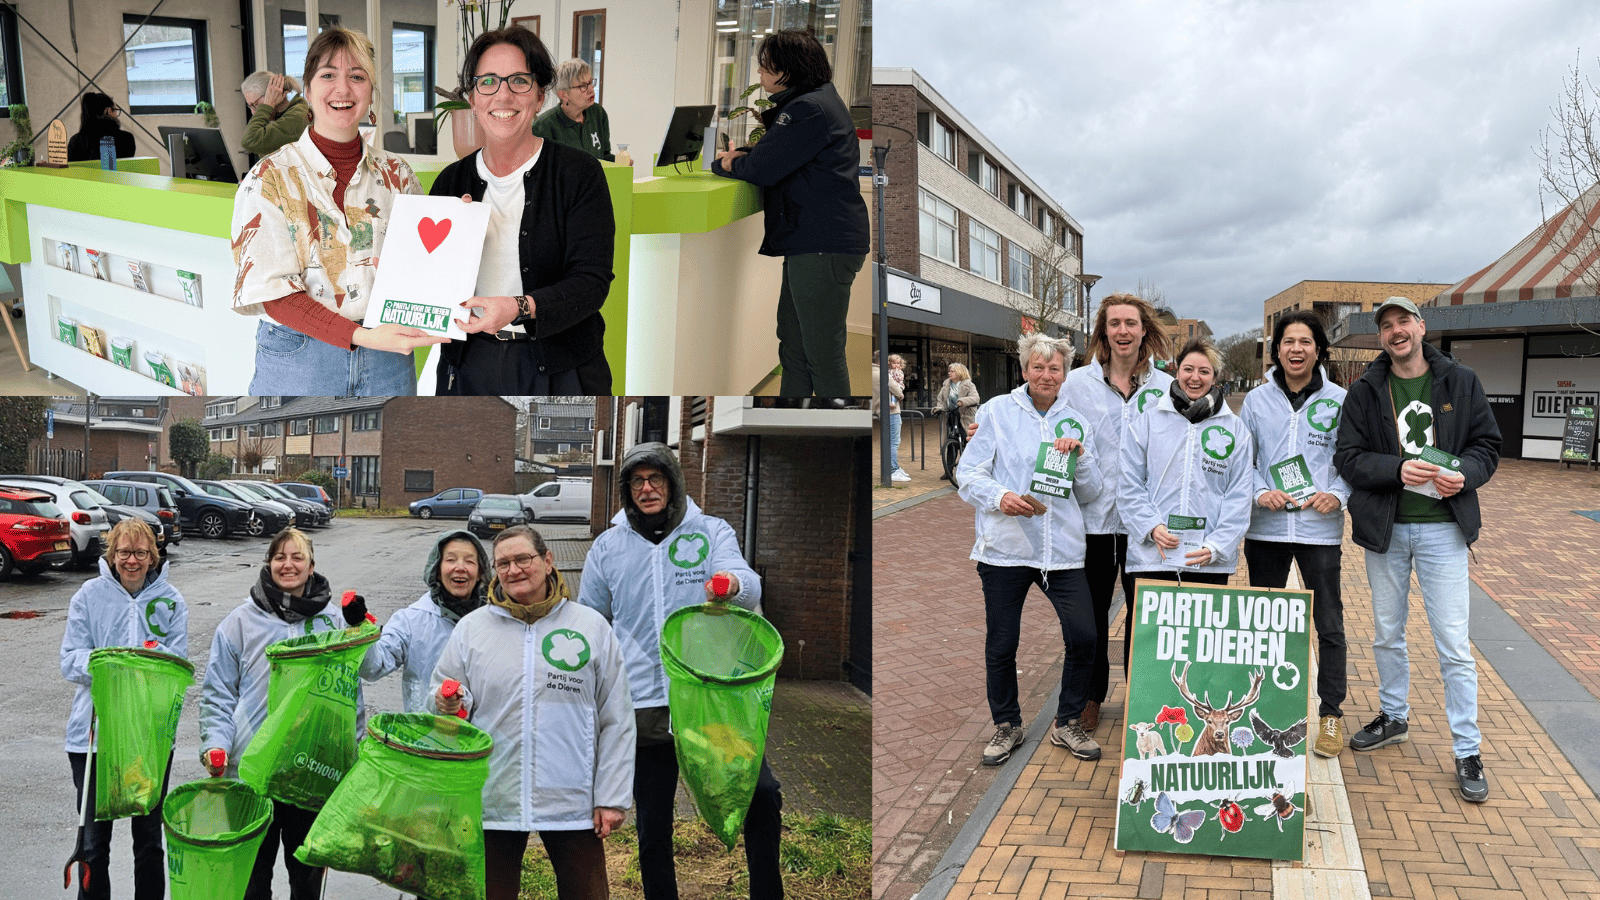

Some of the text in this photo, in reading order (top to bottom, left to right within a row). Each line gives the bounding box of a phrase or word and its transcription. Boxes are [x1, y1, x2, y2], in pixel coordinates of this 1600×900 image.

[382, 308, 446, 330] NATUURLIJK.
[1141, 590, 1306, 633] PARTIJ VOOR
[1156, 625, 1286, 667] DE DIEREN
[547, 672, 583, 684] Partij voor
[547, 681, 580, 693] de Dieren
[1151, 760, 1284, 792] NATUURLIJK.
